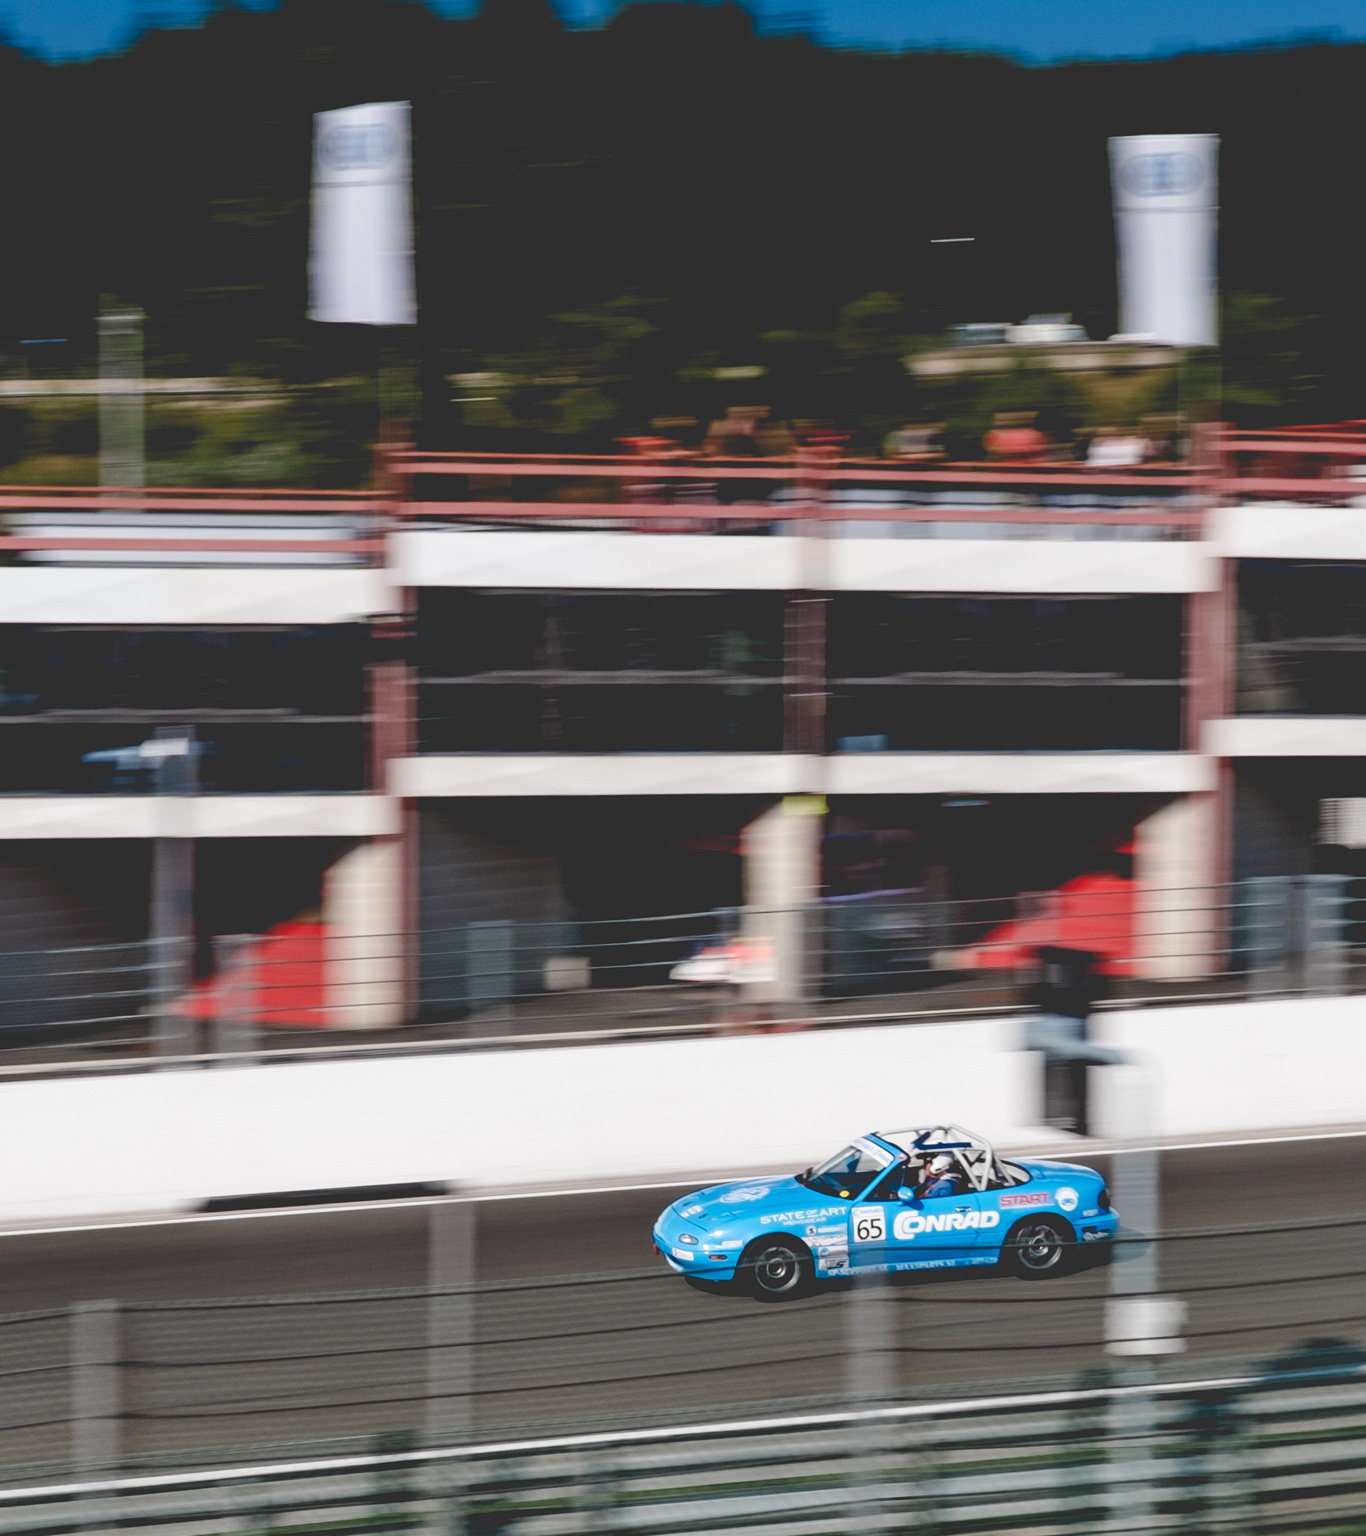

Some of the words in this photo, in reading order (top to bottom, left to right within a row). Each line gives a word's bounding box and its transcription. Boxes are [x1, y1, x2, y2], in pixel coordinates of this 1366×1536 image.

[1000, 1193, 1049, 1206] START
[760, 1211, 805, 1224] STATE
[819, 1207, 847, 1217] ART
[783, 1217, 827, 1226] MENSWEAR
[857, 1218, 882, 1240] 65
[893, 1210, 1000, 1240] CONRAD
